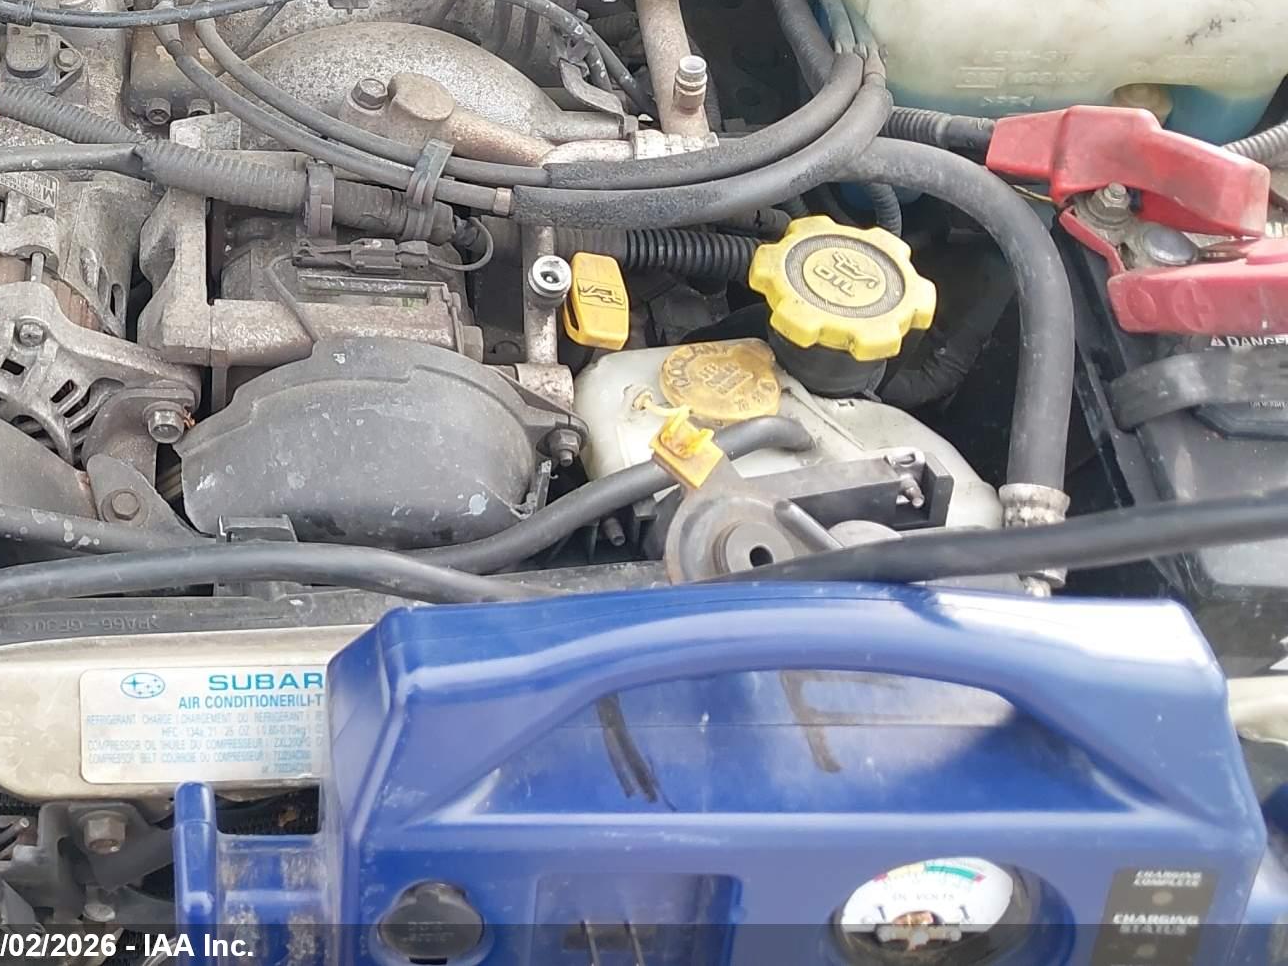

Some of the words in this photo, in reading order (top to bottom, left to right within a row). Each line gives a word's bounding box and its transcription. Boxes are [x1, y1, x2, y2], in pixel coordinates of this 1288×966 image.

[813, 265, 854, 297] OIL
[208, 673, 323, 691] SUBAR
[178, 697, 200, 709] AIR
[88, 740, 140, 751] COMPRESSOR
[1113, 914, 1199, 926] CHARGING
[1119, 923, 1187, 935] STATUS
